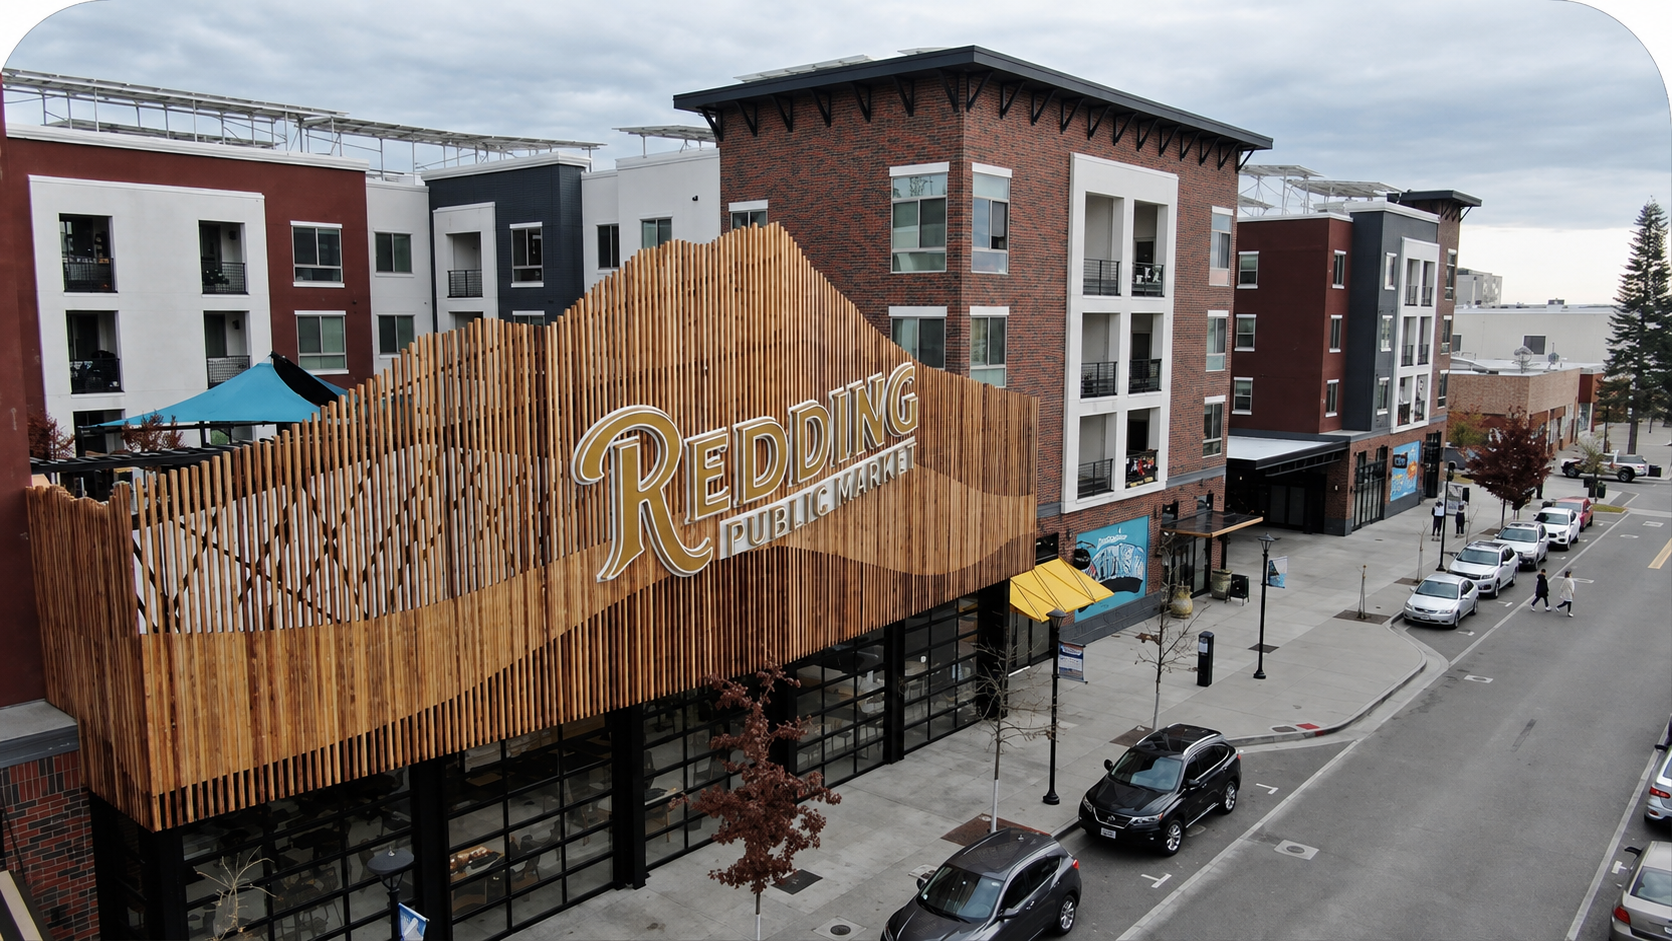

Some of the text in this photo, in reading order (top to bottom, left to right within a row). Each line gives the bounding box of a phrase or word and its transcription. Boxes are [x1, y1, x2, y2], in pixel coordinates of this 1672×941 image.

[572, 362, 918, 582] REDDING
[726, 441, 918, 556] PUBLIC MARKET
